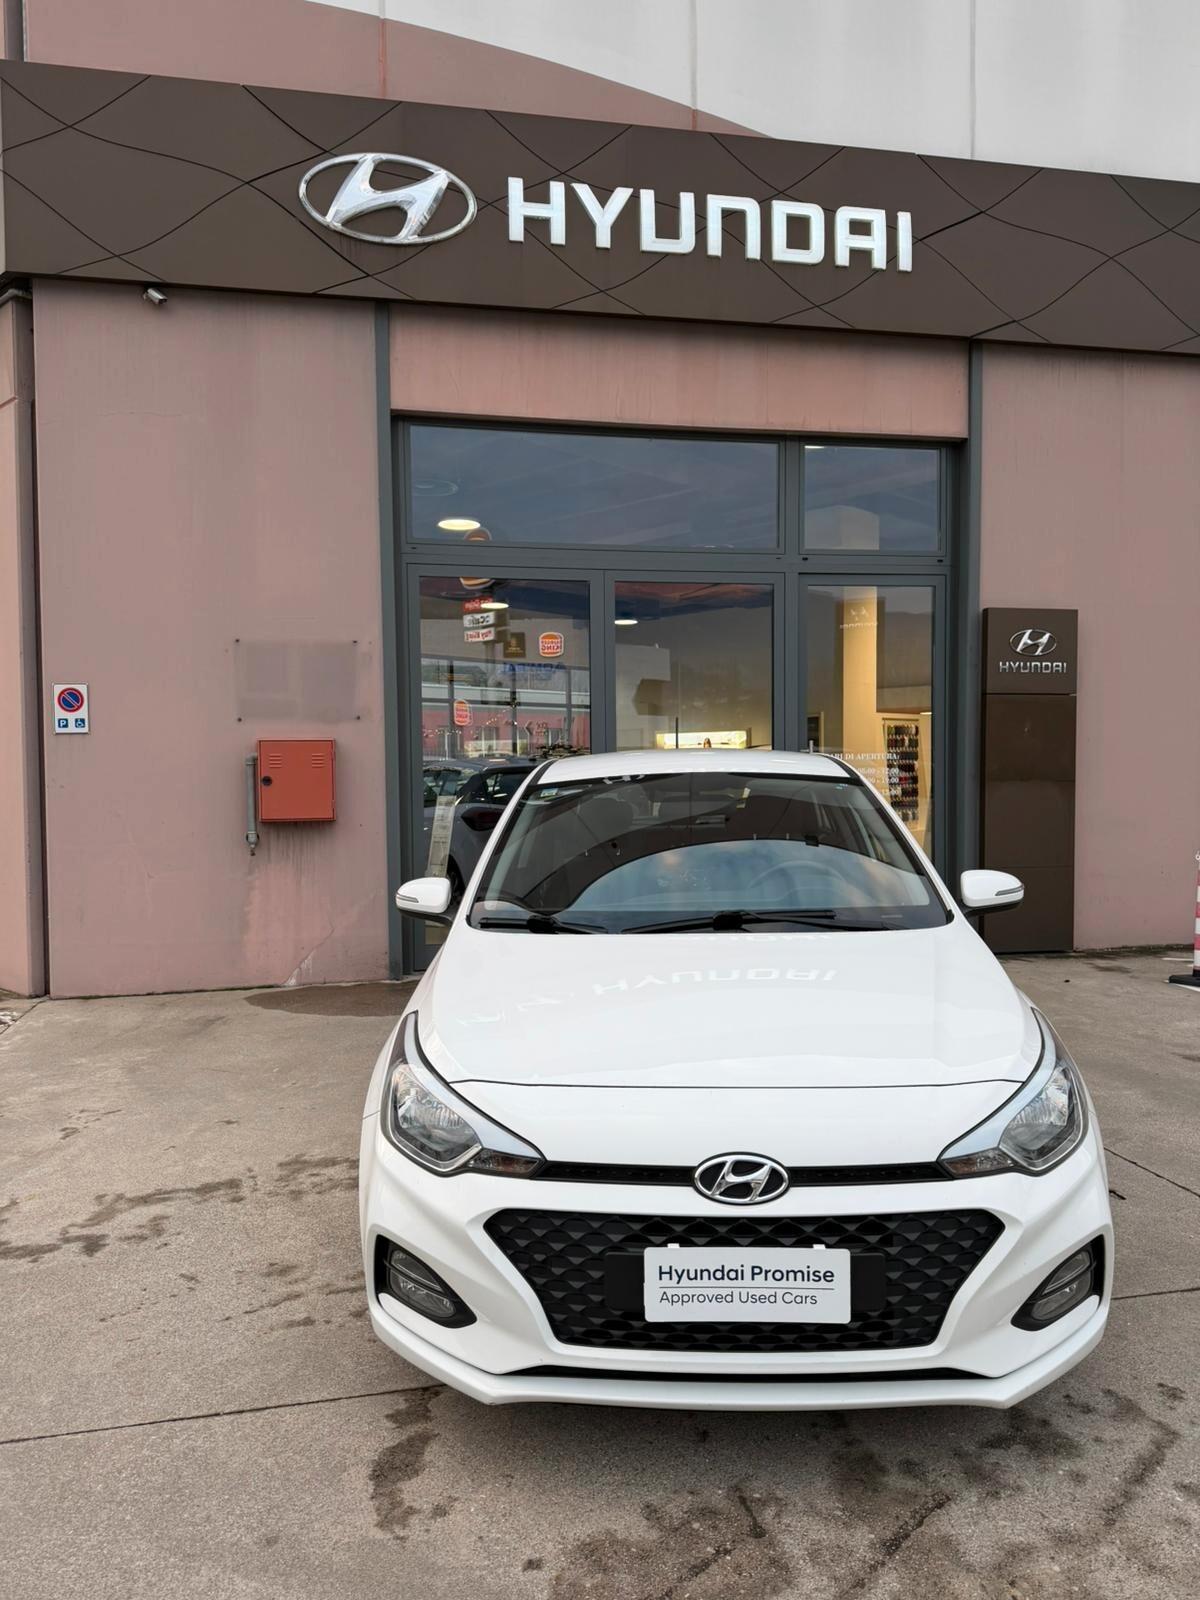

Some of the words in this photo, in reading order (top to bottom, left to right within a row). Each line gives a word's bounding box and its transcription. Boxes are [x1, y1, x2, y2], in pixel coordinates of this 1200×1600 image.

[507, 176, 913, 272] HYUNDAI
[999, 661, 1067, 673] HYUNDAI
[60, 719, 67, 728] P
[658, 1264, 745, 1285] Hyundai
[751, 1265, 835, 1283] Promise
[659, 1290, 734, 1306] Approved
[738, 1291, 778, 1304] Used
[781, 1291, 818, 1305] Cars
